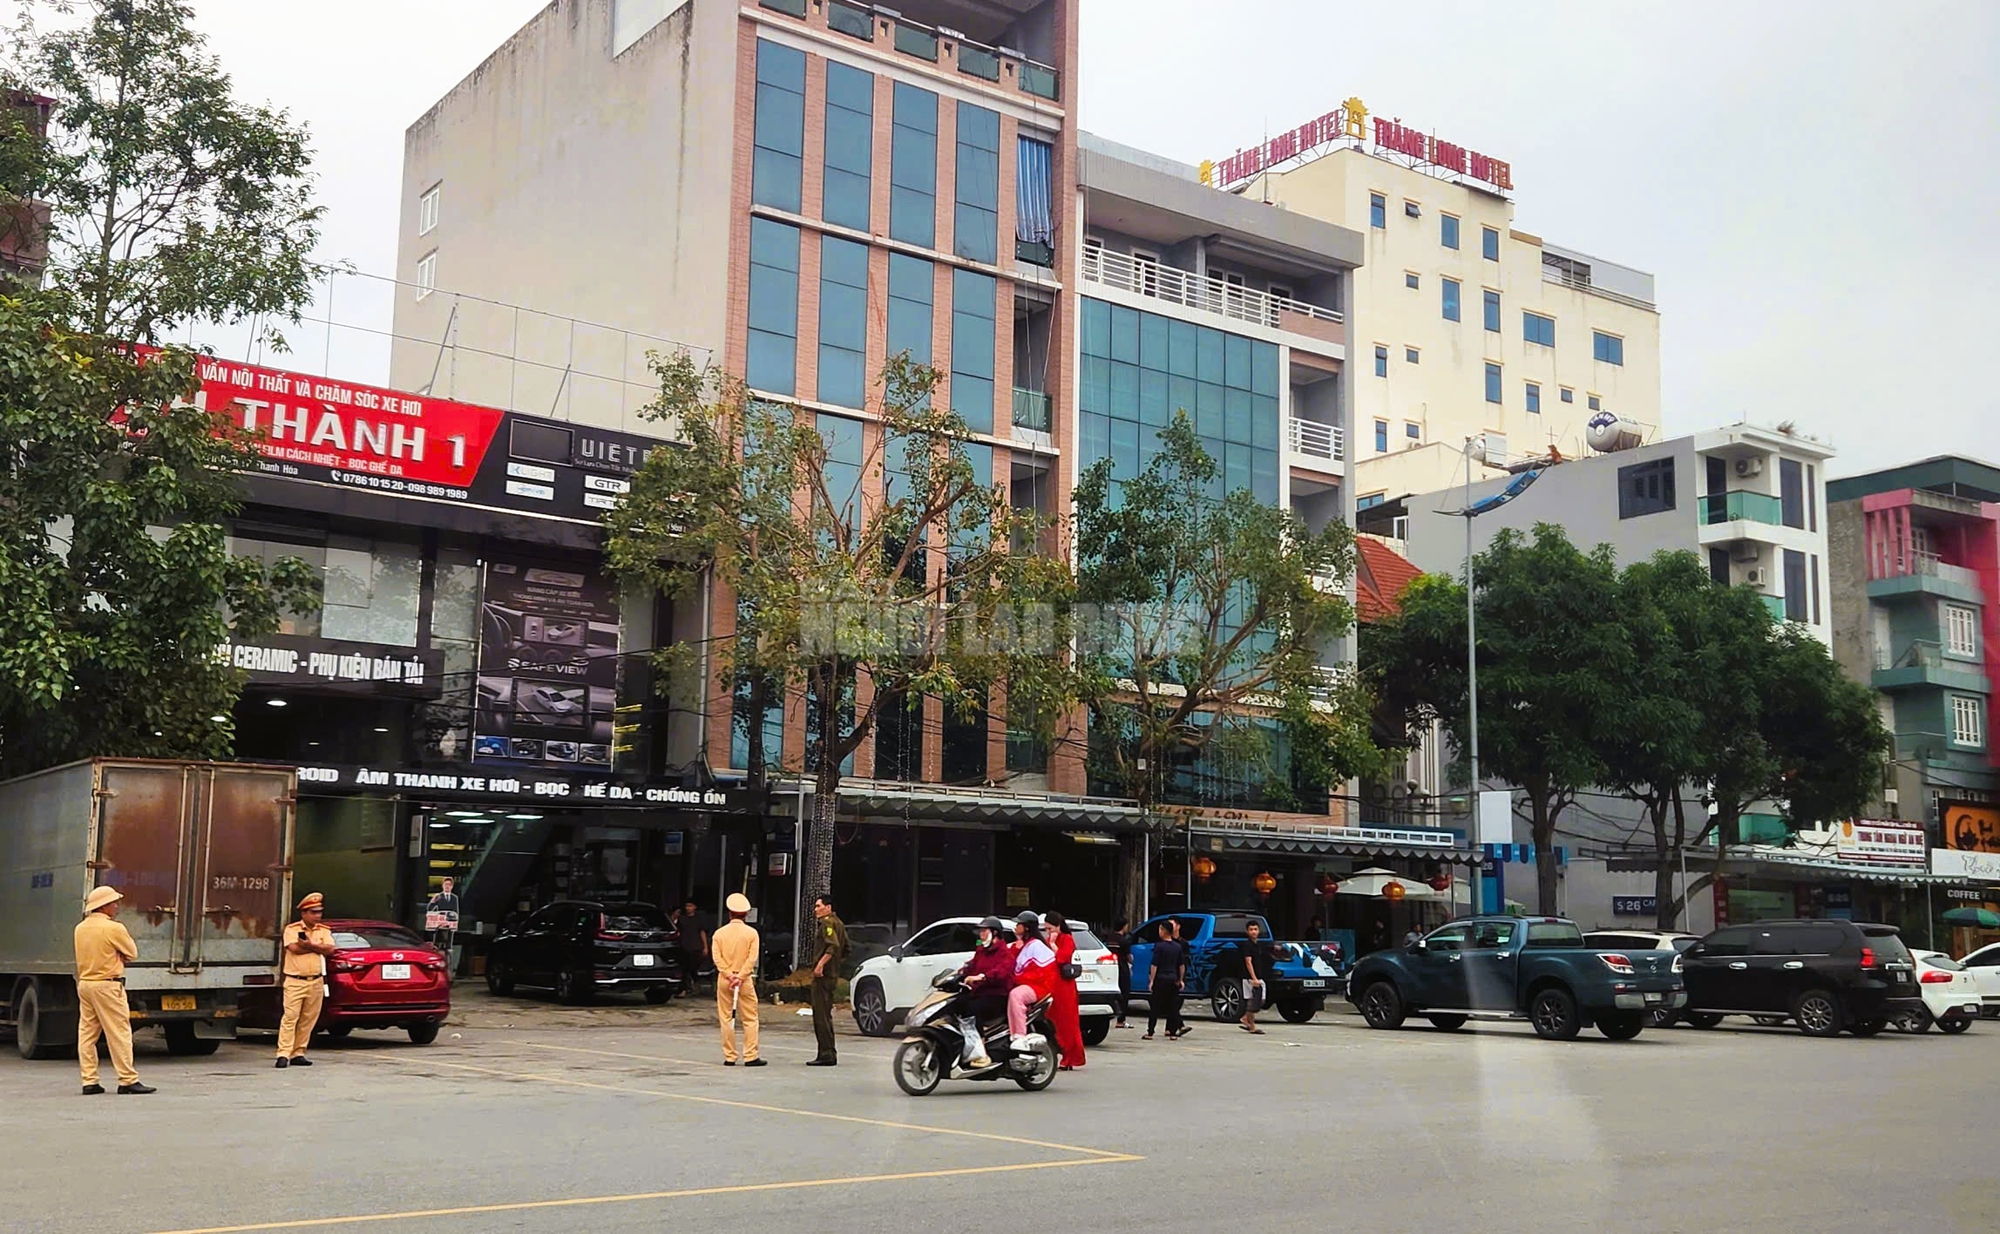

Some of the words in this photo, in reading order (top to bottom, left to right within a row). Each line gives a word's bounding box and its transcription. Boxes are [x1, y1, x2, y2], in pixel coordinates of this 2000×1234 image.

[1299, 109, 1342, 150] HOTEL
[1373, 117, 1425, 160] THĂNG
[1428, 136, 1467, 175] LONG
[1471, 151, 1514, 190] HOTEL
[201, 360, 228, 383] VẤN
[231, 368, 253, 389] NỘI
[258, 372, 291, 394] THẤT
[295, 379, 311, 398] VÀ
[315, 384, 351, 405] CHĂM
[355, 390, 379, 410] SÓC
[381, 397, 399, 413] XE
[401, 401, 422, 417] HƠI
[233, 396, 425, 462] THÀNH
[447, 434, 466, 468] 1
[286, 447, 312, 462] CÁCH
[349, 458, 367, 471] BỌC
[369, 460, 388, 473] GHẾ
[390, 465, 403, 476] DA
[594, 478, 622, 490] GTR
[233, 645, 299, 674] CERAMIC
[309, 652, 337, 681] PHỤ
[339, 652, 371, 681] KIỆN
[373, 655, 402, 682] BÁN
[404, 655, 424, 684] TẢI
[356, 768, 389, 785] ÂM
[394, 773, 457, 789] THANH
[460, 777, 486, 792] XE
[489, 778, 520, 793] HƠI
[534, 781, 570, 797] BỌC
[609, 786, 633, 800] DA
[646, 786, 700, 804] CHỐNG
[1626, 900, 1641, 911] 26
[1947, 889, 1981, 900] COFFEE
